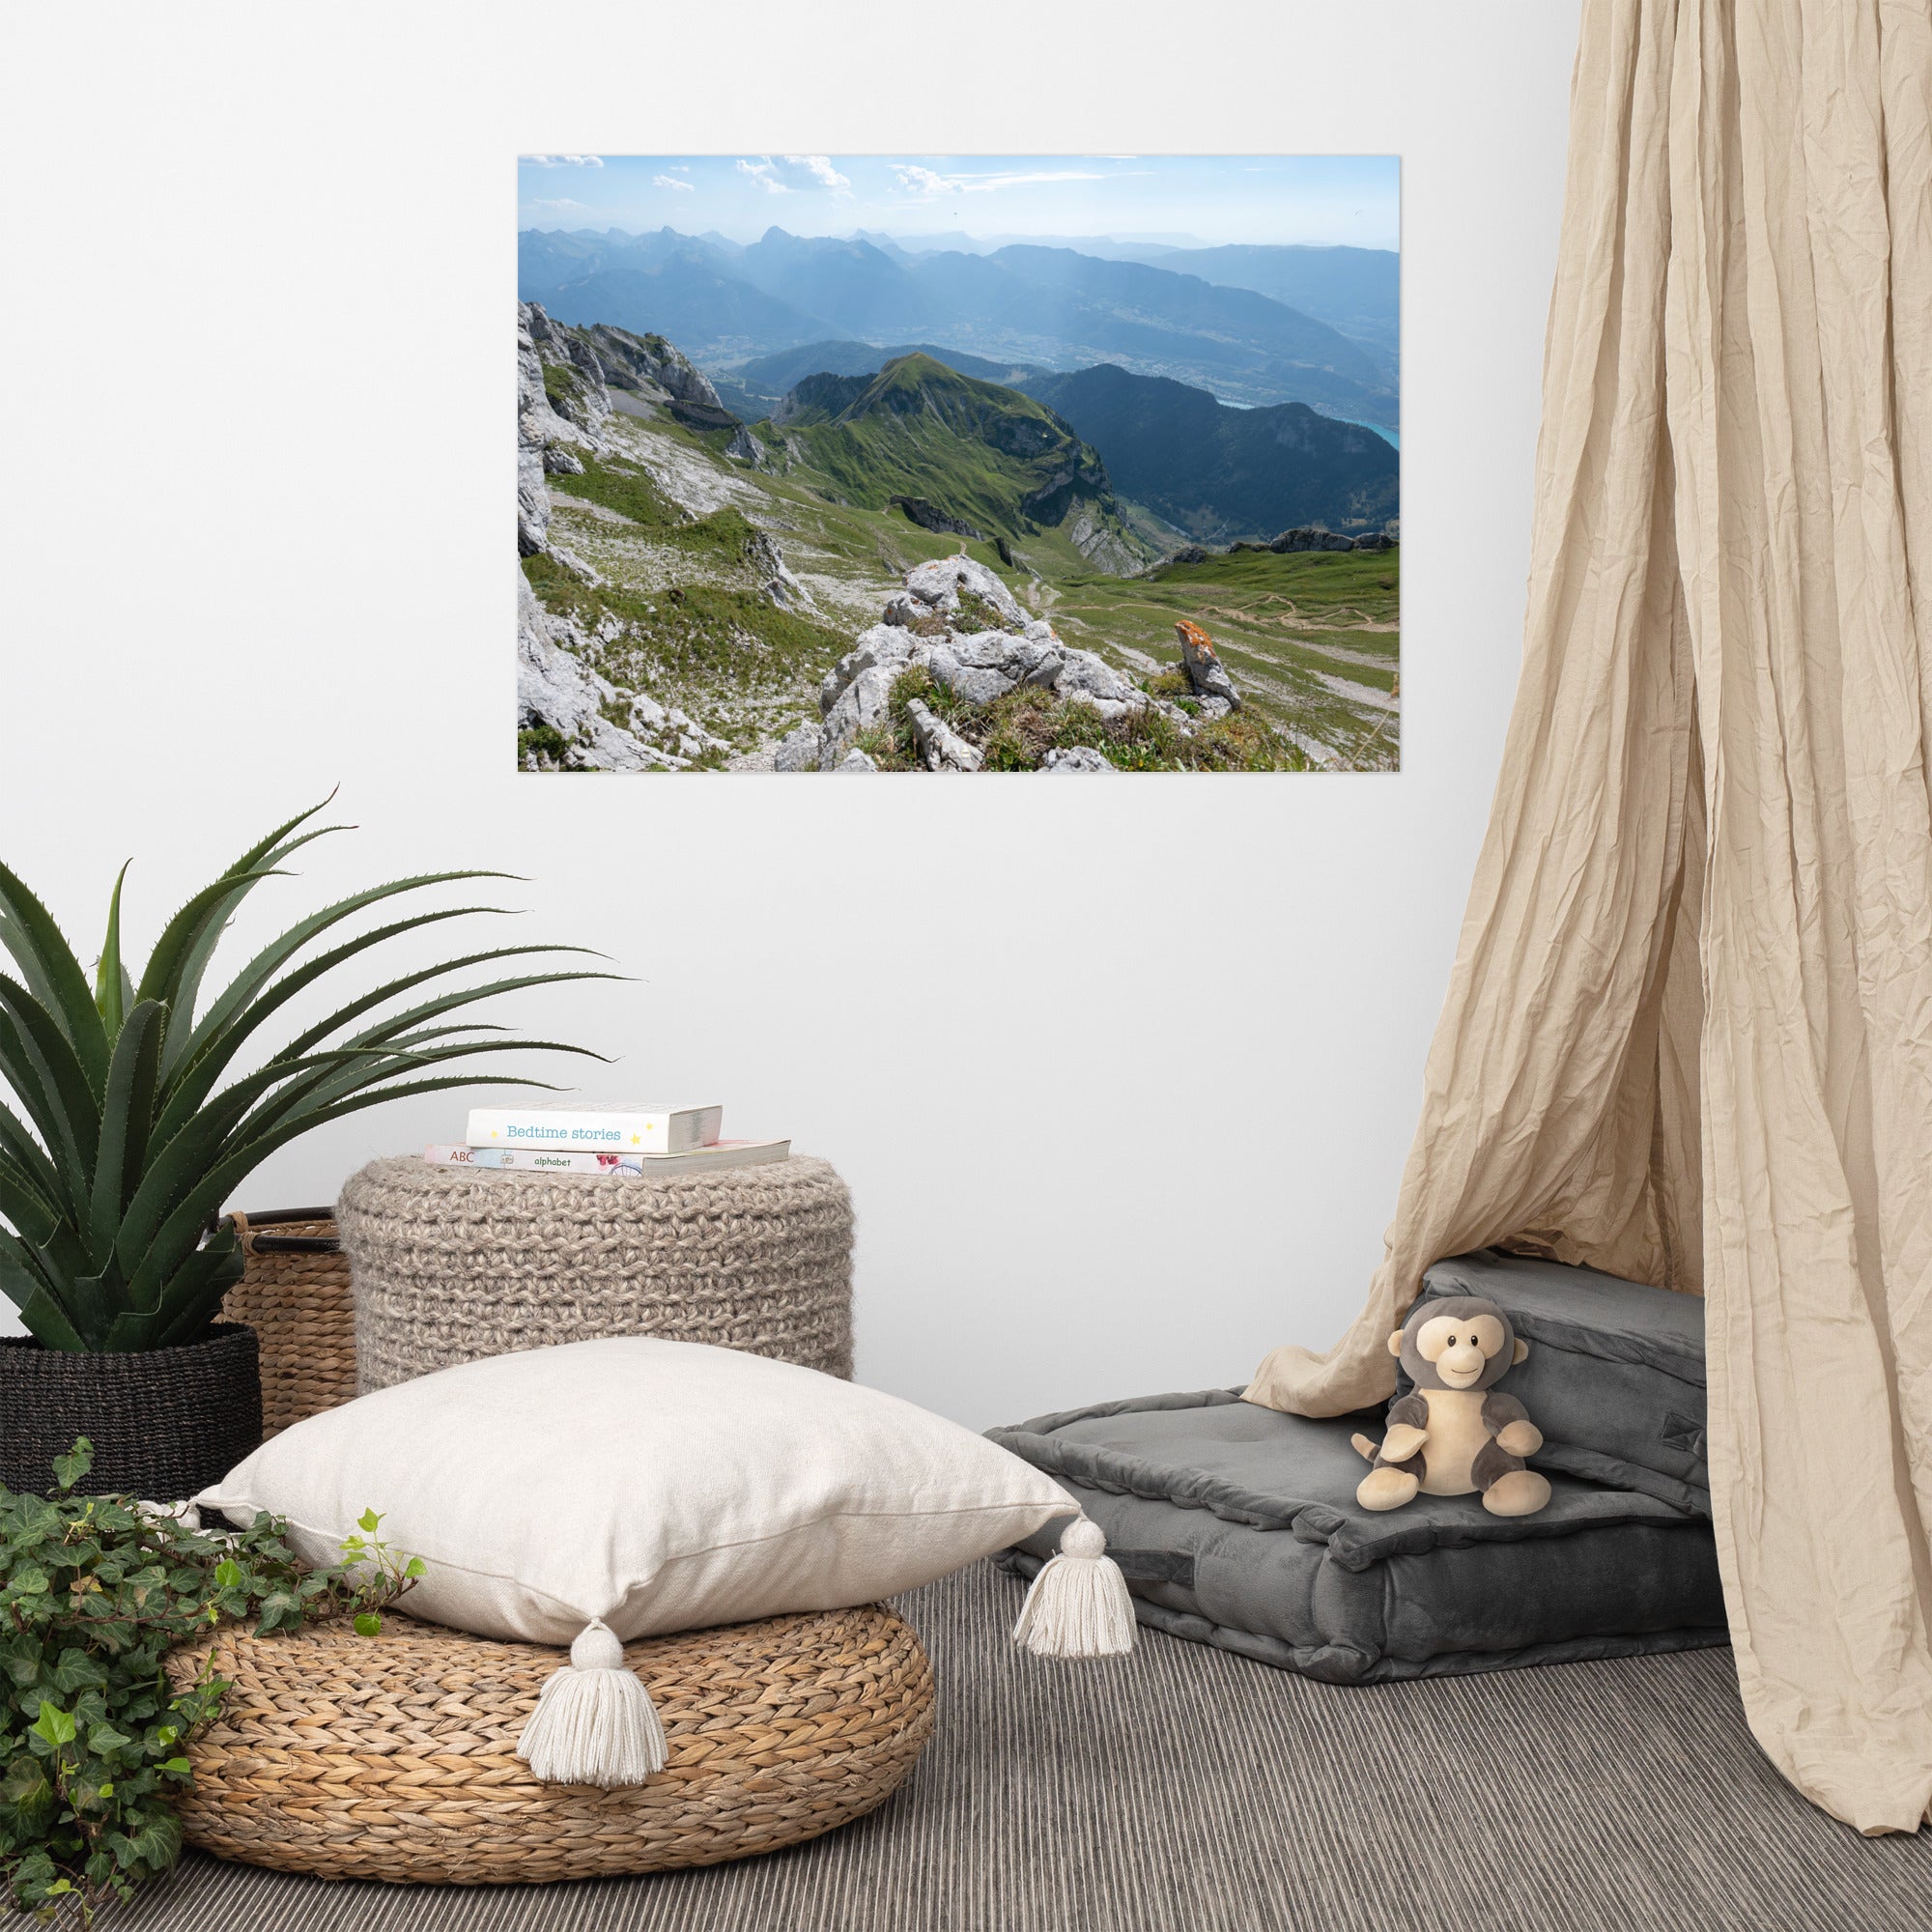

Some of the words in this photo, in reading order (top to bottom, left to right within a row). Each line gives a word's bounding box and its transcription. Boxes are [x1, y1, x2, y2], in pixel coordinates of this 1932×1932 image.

[506, 1125, 568, 1139] Bedtime
[571, 1128, 621, 1141] stories
[450, 1151, 475, 1163] ABC
[534, 1157, 571, 1168] alphabet
